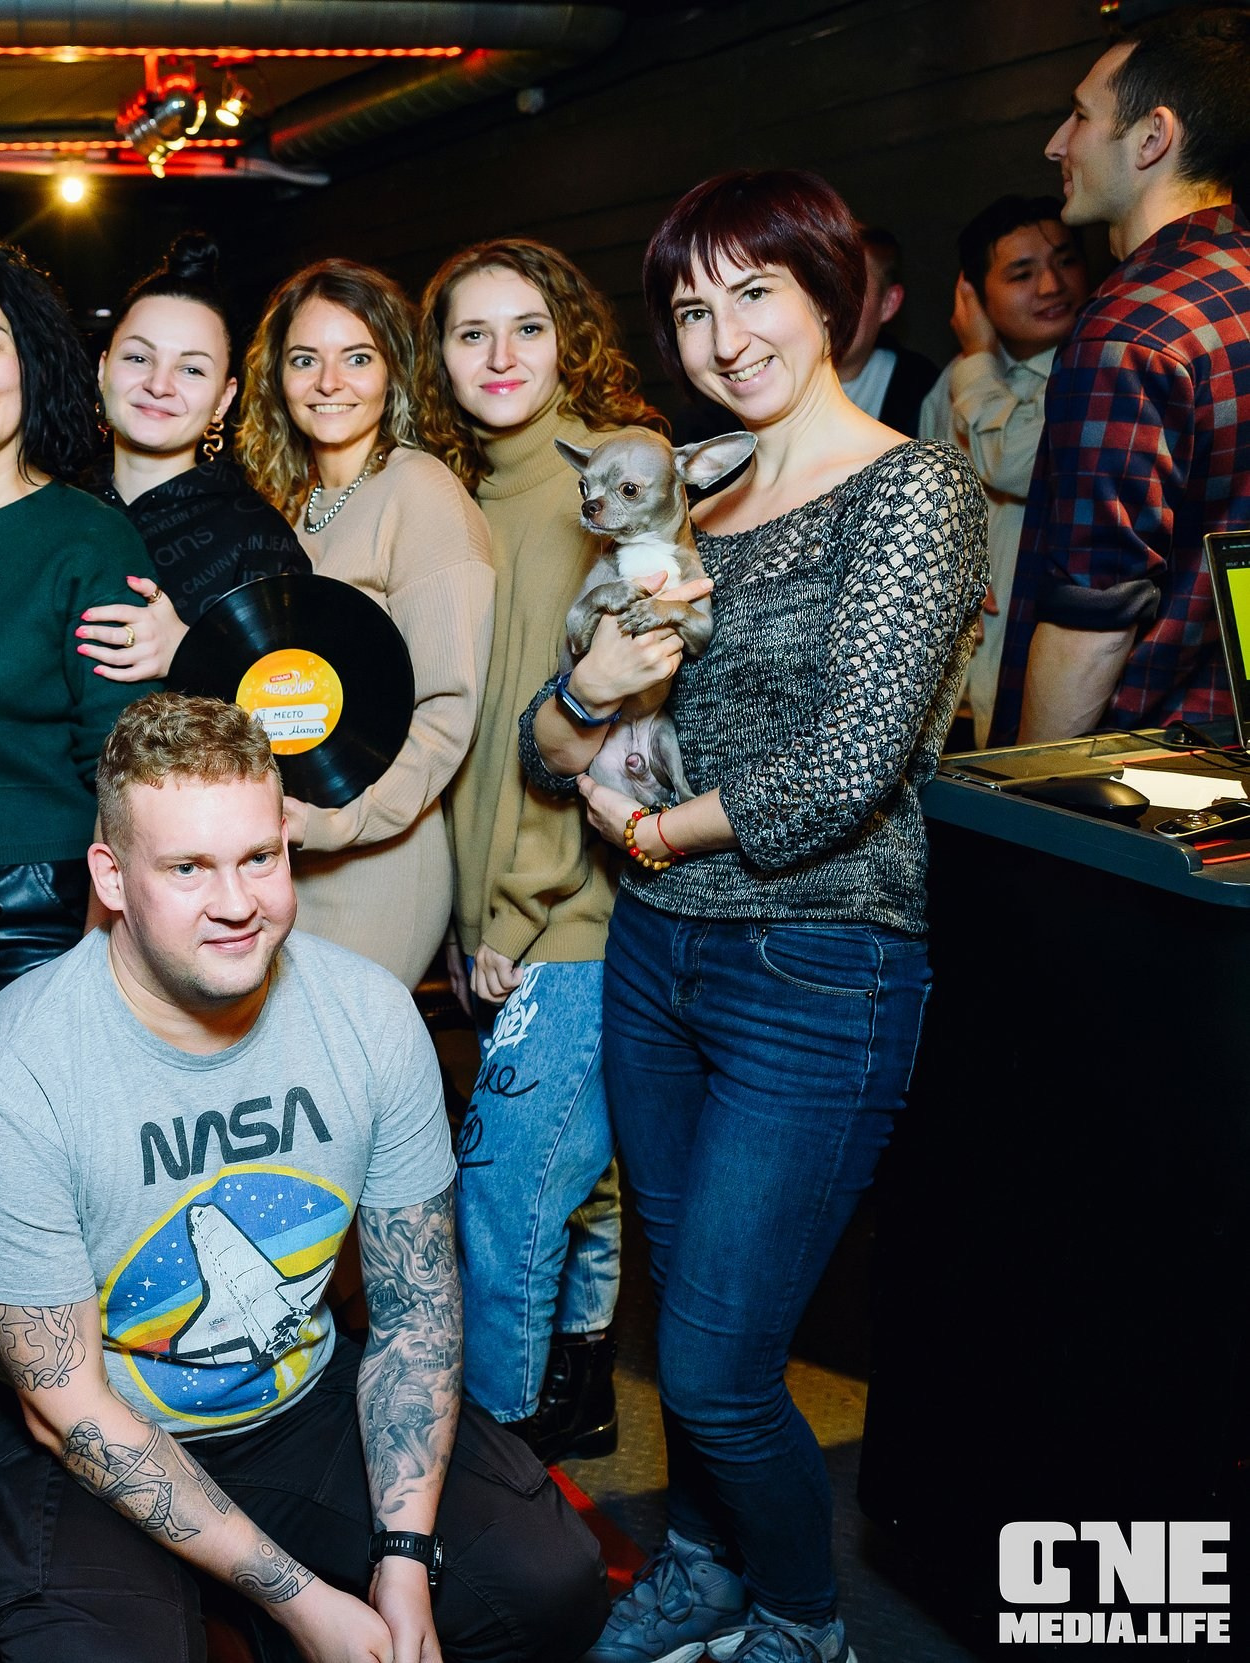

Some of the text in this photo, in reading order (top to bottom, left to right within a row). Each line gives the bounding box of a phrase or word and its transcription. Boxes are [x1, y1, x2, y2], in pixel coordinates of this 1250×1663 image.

[181, 556, 232, 595] CALVIN
[273, 710, 304, 720] МЕСТО
[140, 1086, 333, 1186] NASA
[208, 1317, 225, 1326] USA
